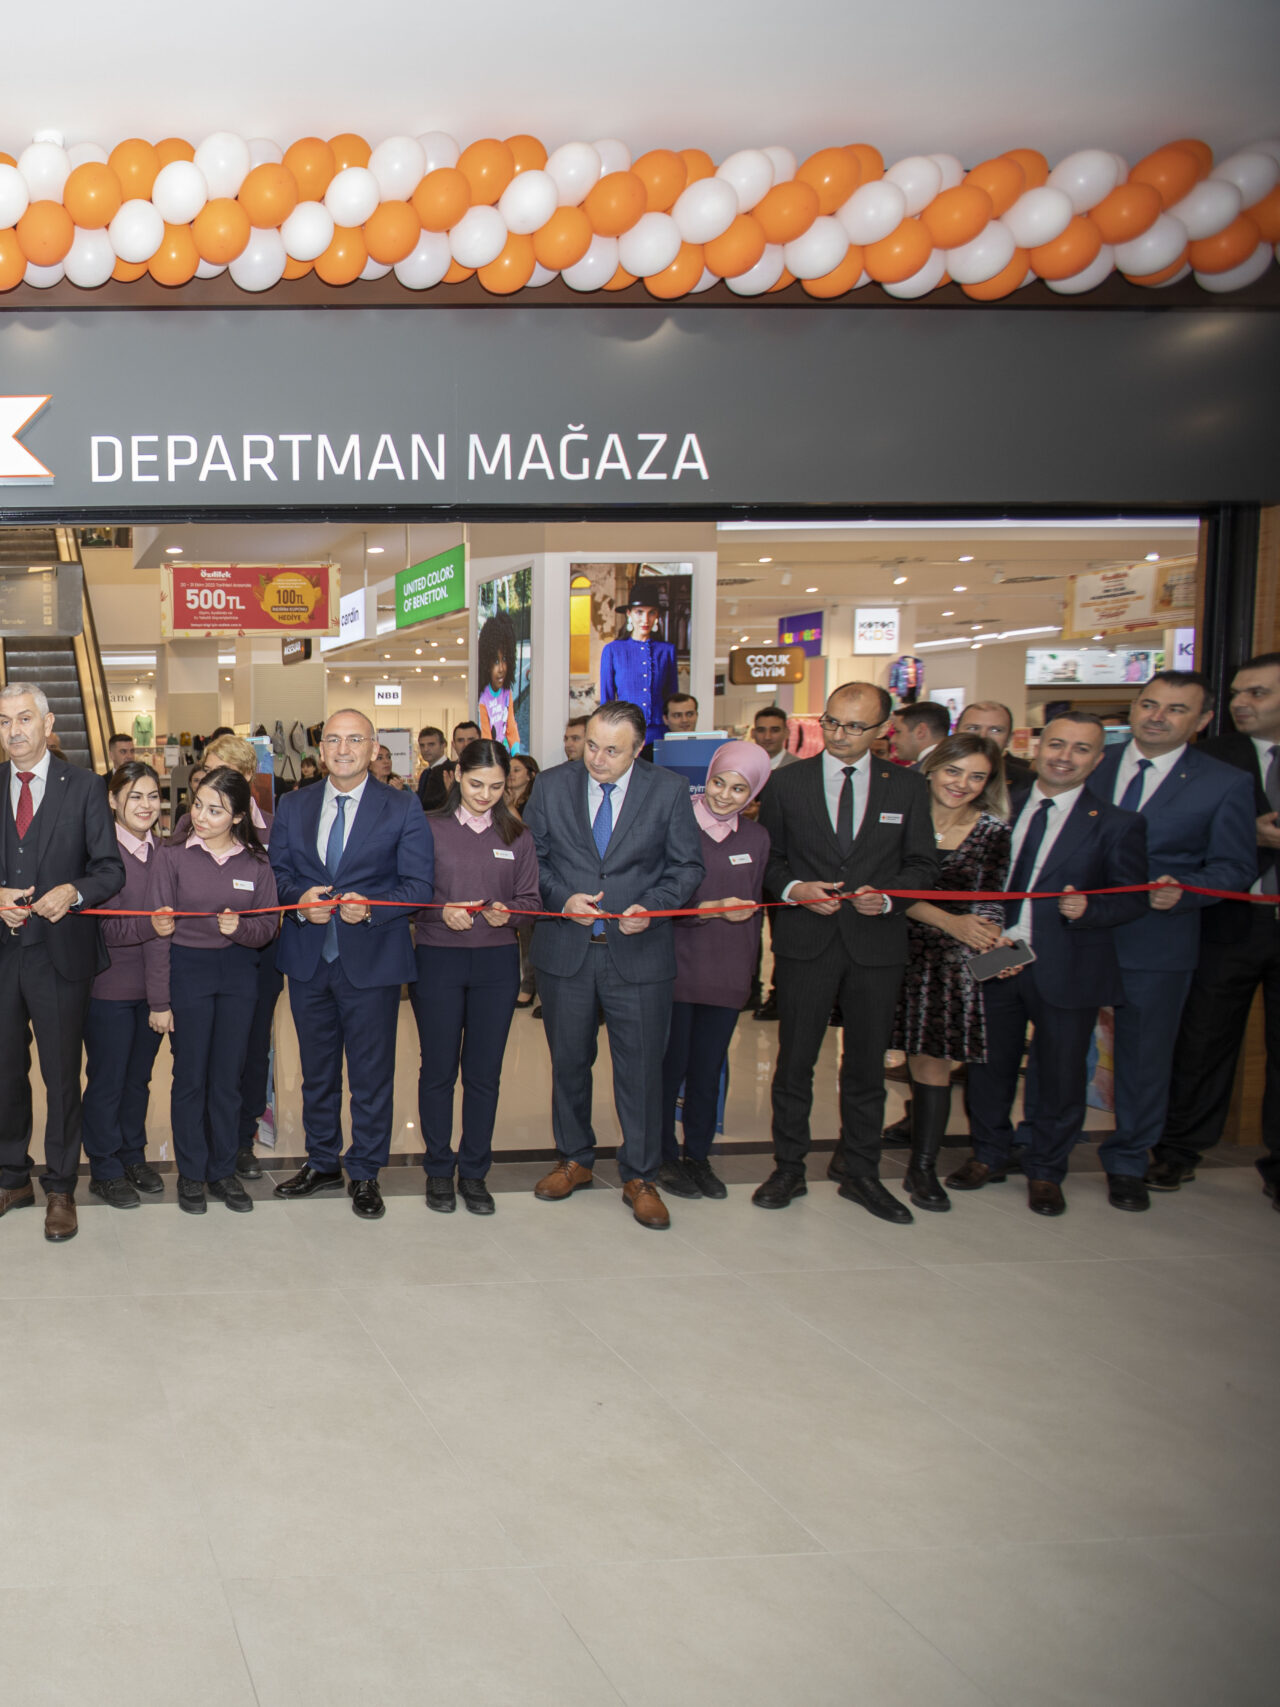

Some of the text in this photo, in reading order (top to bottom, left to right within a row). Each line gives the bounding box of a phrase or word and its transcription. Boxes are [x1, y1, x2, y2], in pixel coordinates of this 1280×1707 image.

[90, 423, 711, 483] DEPARTMAN MAĞAZA
[200, 569, 231, 578] Özdilek
[403, 564, 454, 596] UNITED COLORS
[403, 598, 413, 612] OF
[746, 654, 791, 667] ÇOCUK
[751, 665, 785, 677] GİYİM
